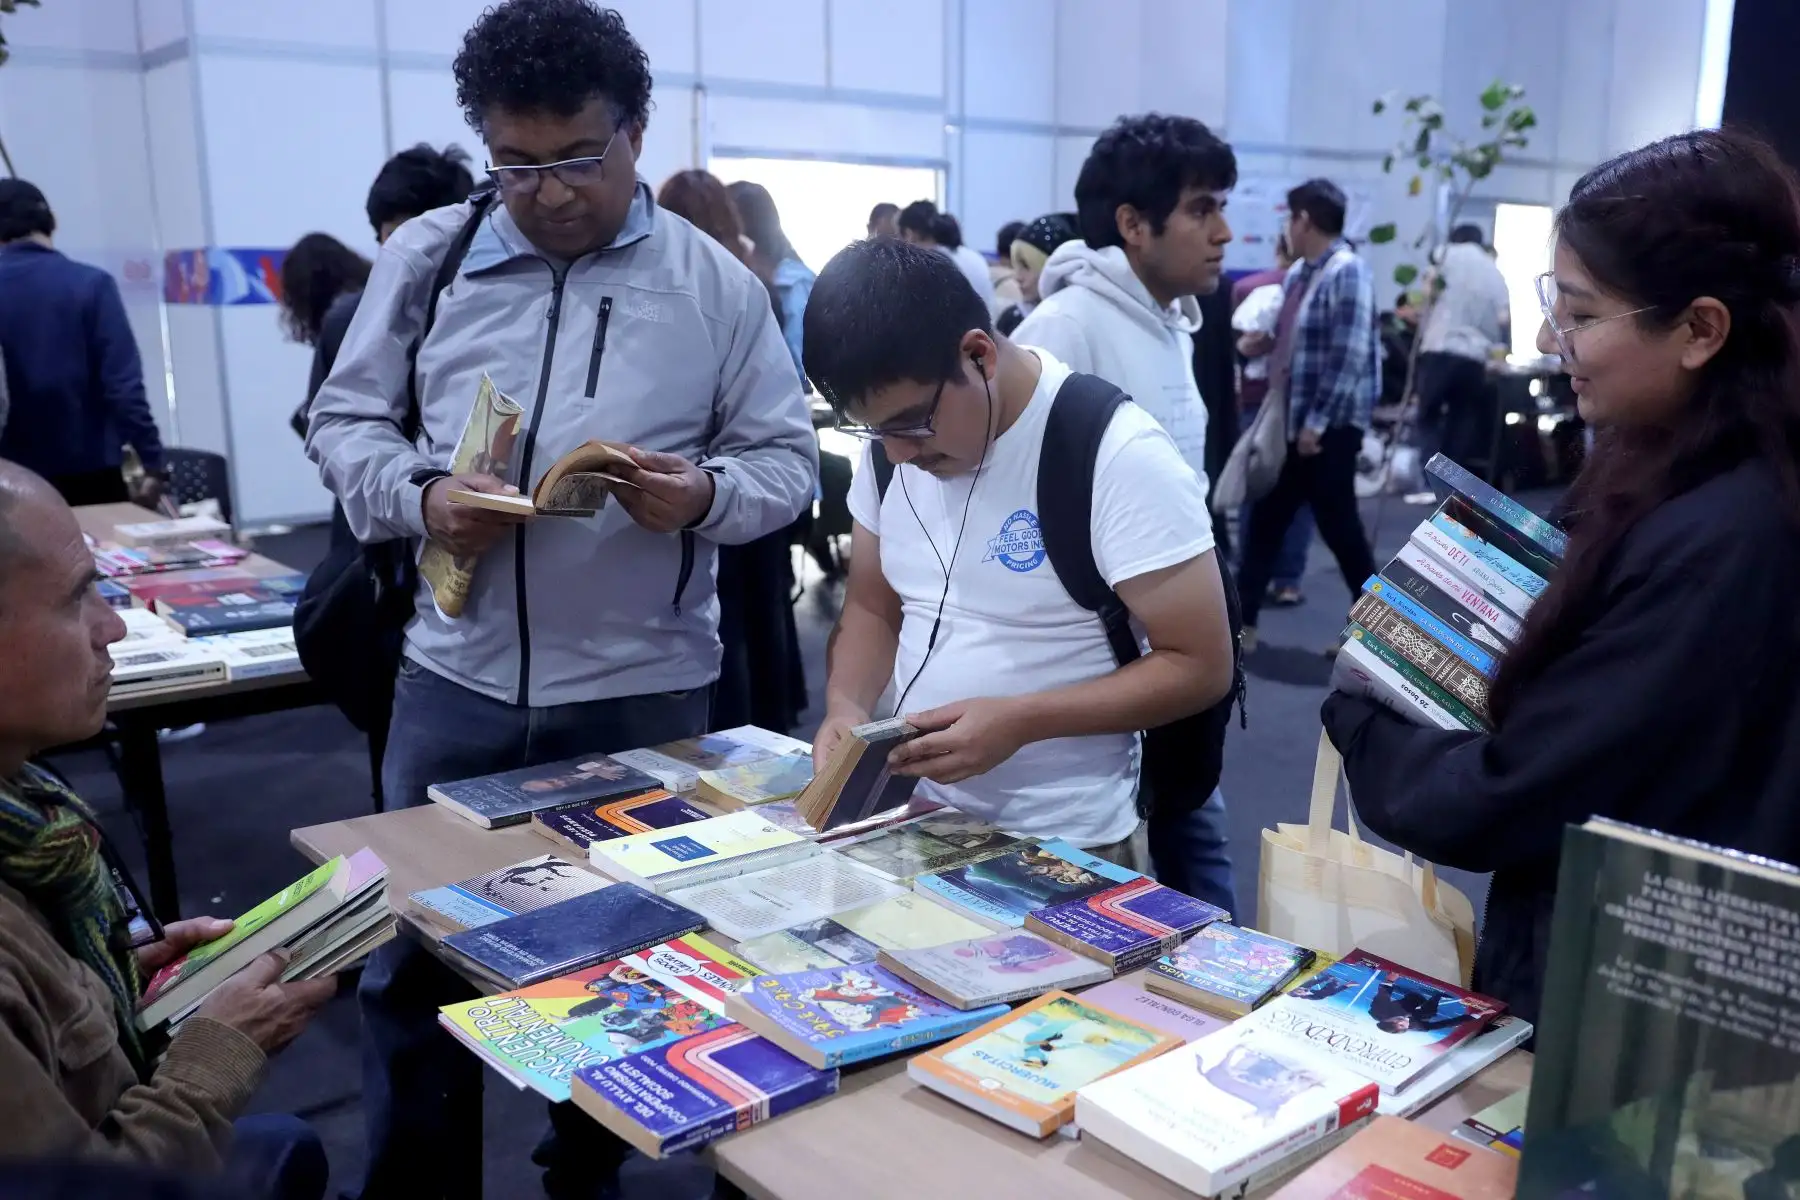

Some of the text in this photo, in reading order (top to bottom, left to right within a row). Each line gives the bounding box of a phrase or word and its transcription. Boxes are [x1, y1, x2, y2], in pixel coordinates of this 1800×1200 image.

[1498, 503, 1520, 519] BARCO
[1004, 519, 1011, 531] NO
[1000, 533, 1019, 542] FEEL
[995, 542, 1028, 553] MOTORS
[1447, 545, 1461, 560] DE
[1457, 553, 1470, 567] TI
[1007, 560, 1037, 569] PRICING
[1365, 604, 1381, 622] WILLIAM
[1461, 590, 1499, 624] VENTANA
[1418, 698, 1429, 709] 26
[1063, 910, 1114, 934] ADOLESCENTE
[1077, 922, 1111, 939] RETRATO
[1080, 930, 1095, 939] EL
[653, 957, 681, 973] TODOS
[1158, 964, 1190, 979] Nido
[1194, 976, 1212, 986] sin
[1180, 1013, 1205, 1026] OLGA
[485, 996, 610, 1068] ONUMENTAL!
[971, 1049, 1060, 1089] MUJERCITAS
[618, 1061, 674, 1099] SOCIALISTA
[590, 1069, 654, 1117] DEL AYLLU AL
[604, 1065, 688, 1123] COOPERATIVISMO
